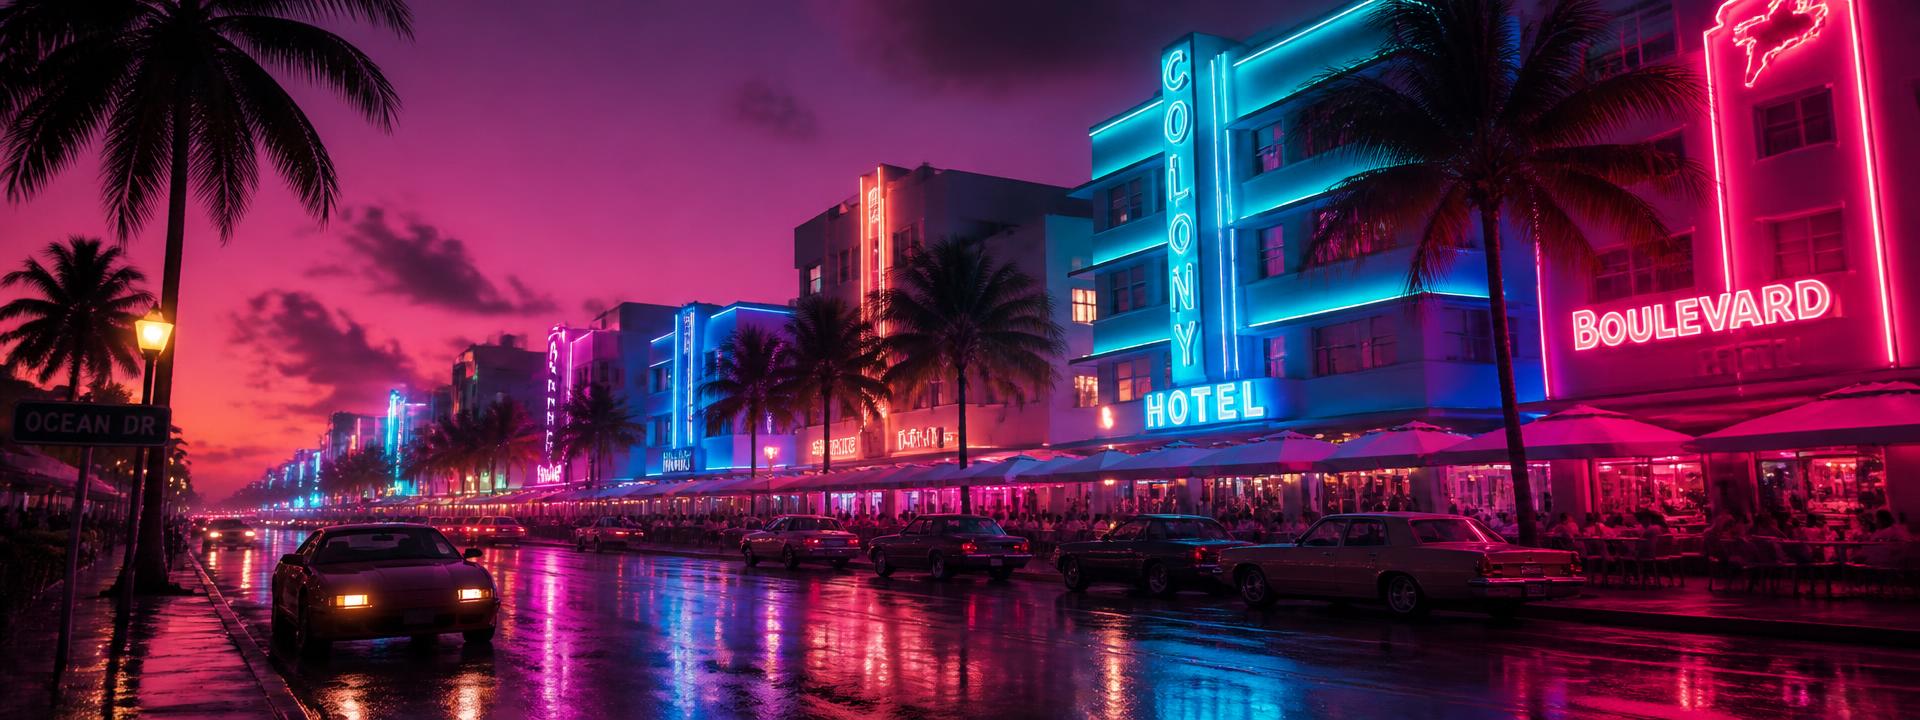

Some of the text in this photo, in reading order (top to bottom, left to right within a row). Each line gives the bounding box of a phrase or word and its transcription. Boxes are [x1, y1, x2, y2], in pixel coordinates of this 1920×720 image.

[1164, 49, 1198, 367] COLONY
[1573, 279, 1830, 350] BOULEVARD
[25, 411, 155, 436] OCEAN DR
[1146, 381, 1264, 428] HOTEL
